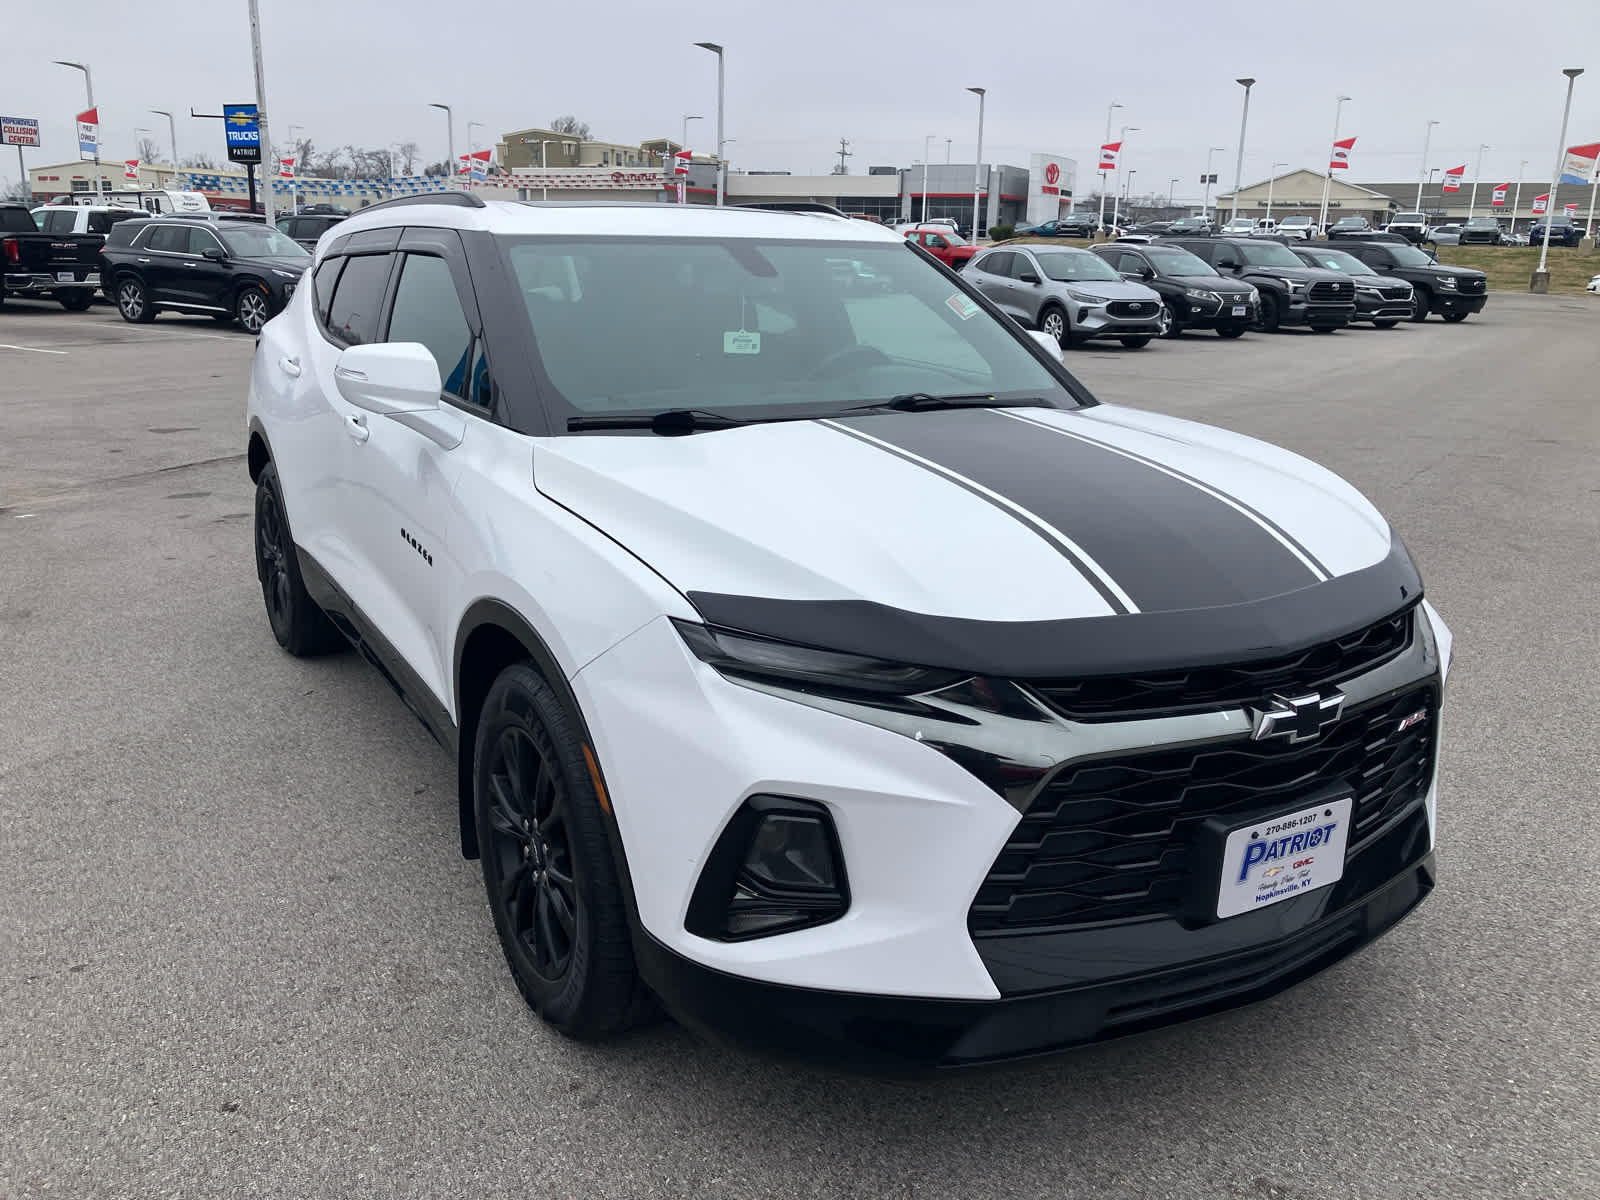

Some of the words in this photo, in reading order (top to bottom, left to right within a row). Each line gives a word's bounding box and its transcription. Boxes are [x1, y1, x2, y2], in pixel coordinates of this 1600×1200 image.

[3, 125, 38, 136] COLLISION
[227, 131, 259, 141] TRUCKS
[8, 135, 34, 144] CENTER
[233, 148, 256, 156] PATRIOT
[400, 527, 433, 567] BLAZER
[1265, 813, 1317, 836] 270-886-1207
[1238, 823, 1337, 882] PATRIOT
[1292, 856, 1315, 869] GMC
[1255, 882, 1300, 903] Hopkinsville,
[1301, 877, 1312, 888] KY
